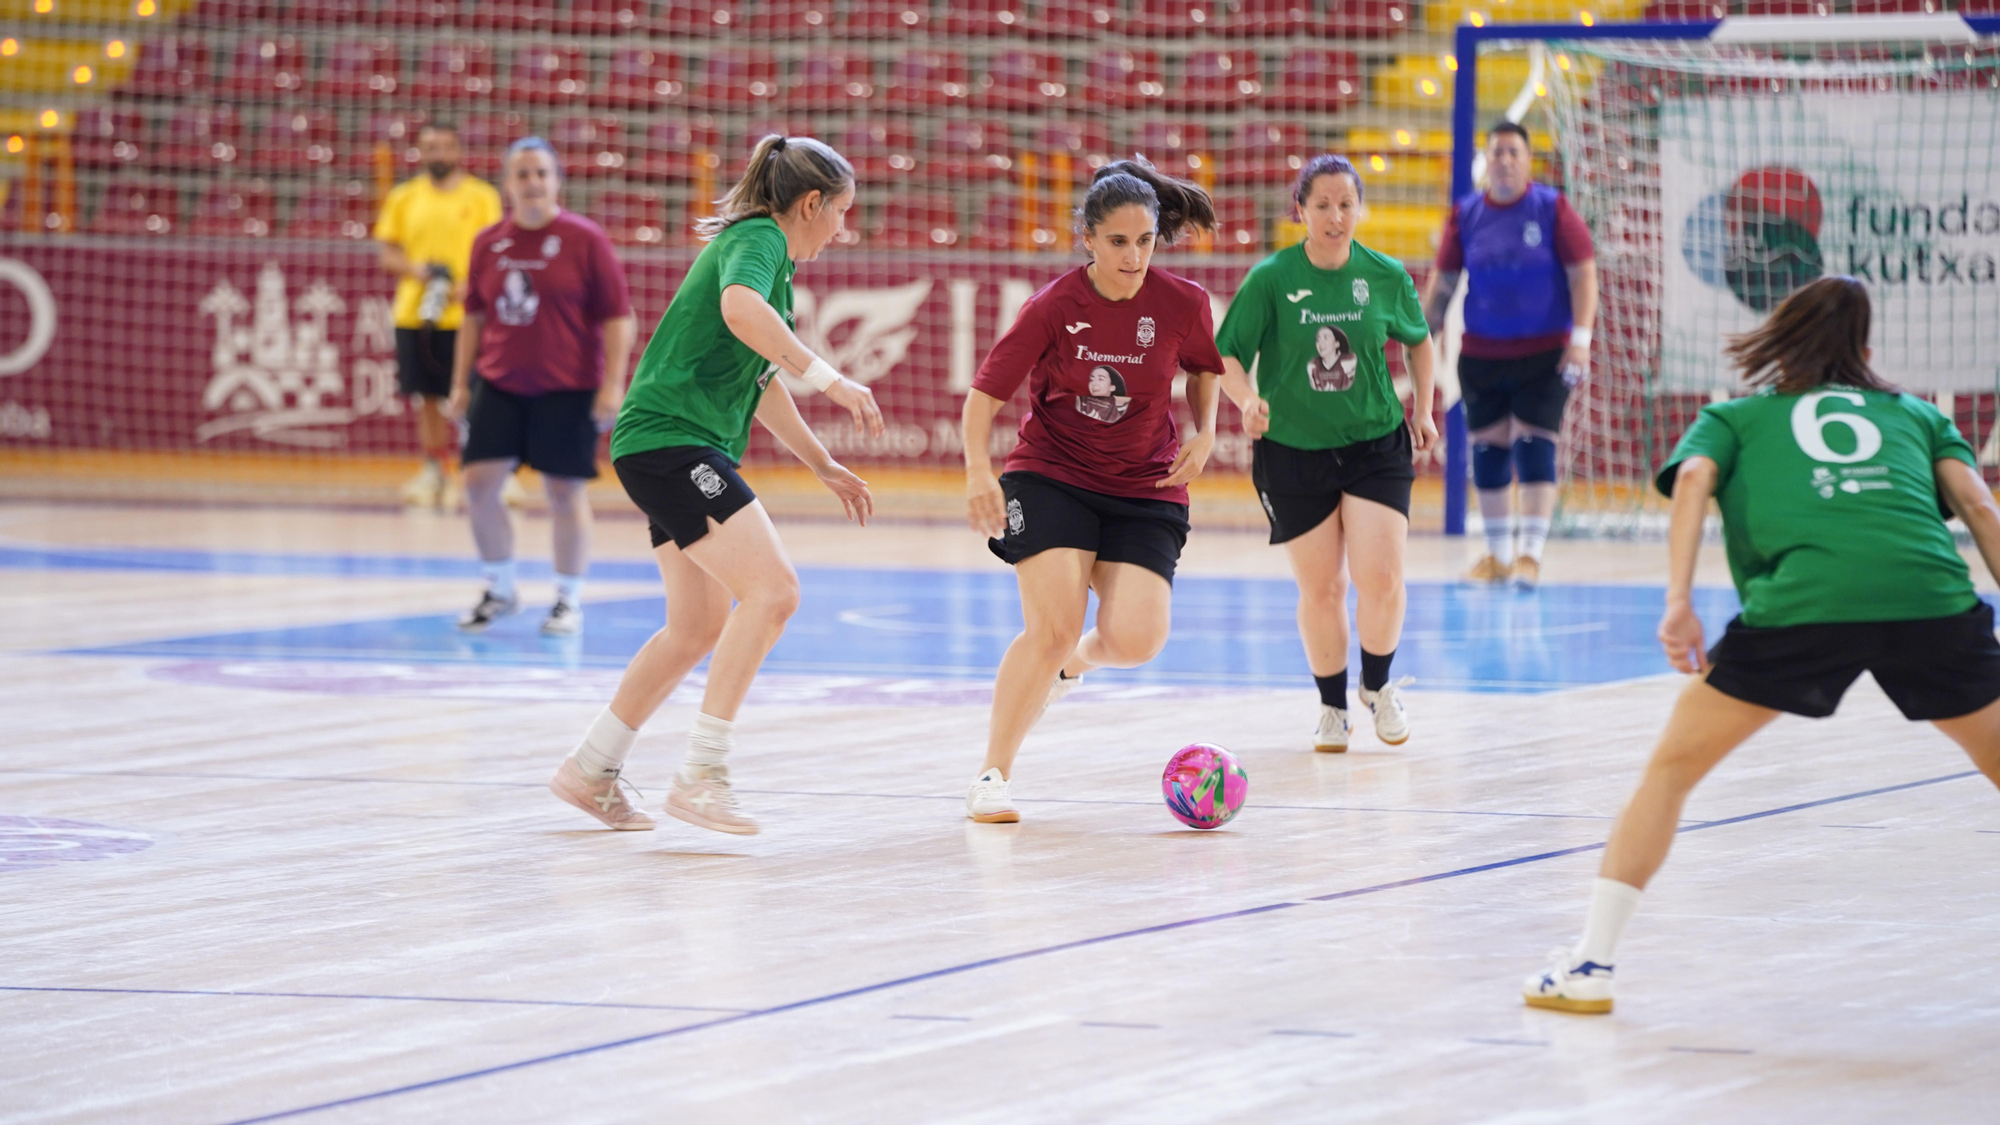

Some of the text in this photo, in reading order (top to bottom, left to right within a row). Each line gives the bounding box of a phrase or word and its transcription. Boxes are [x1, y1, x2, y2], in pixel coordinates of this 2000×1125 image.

[1309, 309, 1363, 323] Memorial
[1084, 351, 1146, 364] Memorial
[1791, 390, 1882, 464] 6
